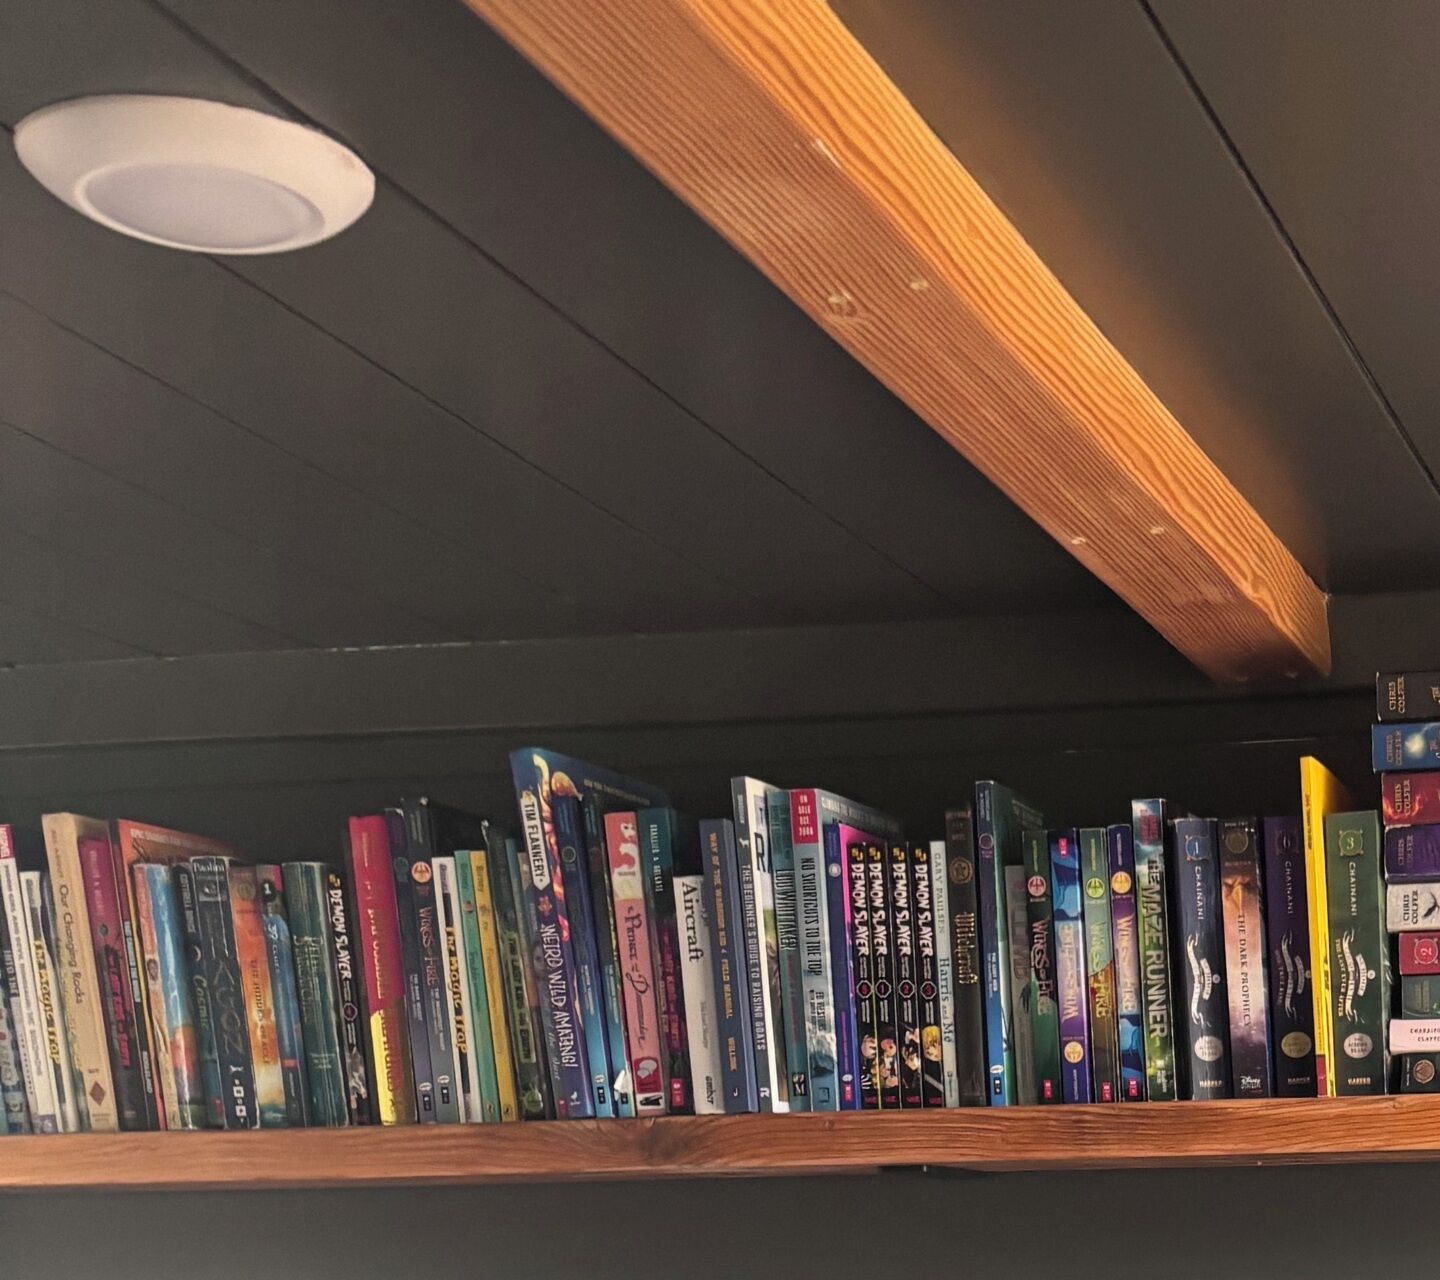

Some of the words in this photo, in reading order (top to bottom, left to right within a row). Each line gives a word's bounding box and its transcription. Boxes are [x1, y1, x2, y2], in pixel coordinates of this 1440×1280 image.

[524, 801, 536, 821] TIM
[527, 822, 545, 879] FLANNERY
[709, 832, 718, 854] WAY
[711, 854, 720, 866] OF
[193, 862, 225, 873] Paolini
[713, 868, 722, 886] THE
[741, 864, 752, 882] THE
[800, 858, 815, 871] NO
[868, 862, 884, 908] DEMON
[892, 862, 909, 908] DEMON
[933, 853, 943, 885] GARY
[1147, 859, 1161, 886] THE
[59, 884, 69, 908] Our
[263, 883, 271, 894] 1
[801, 872, 820, 925] SHORTCUTS
[851, 863, 866, 908] DEMON
[914, 863, 930, 909] DEMON
[1195, 866, 1204, 920] CHAINANI
[1284, 860, 1294, 914] CHAINANI
[1349, 862, 1358, 916] CHAINANI
[329, 889, 347, 932] DEMON
[419, 906, 434, 948] WINGS
[682, 881, 705, 963] Aircraft
[714, 888, 725, 929] WARRIOR
[742, 883, 757, 937] BEGINNER'S
[776, 890, 799, 951] WHITTAKER
[935, 887, 945, 934] PAULSEN
[1141, 887, 1164, 946] MAZE
[1237, 914, 1245, 934] THE
[33, 939, 46, 964] The
[63, 911, 78, 968] Changing
[267, 923, 279, 941] 39
[445, 927, 458, 951] The
[624, 912, 643, 961] PRINCE
[748, 938, 760, 965] GUIDE
[804, 927, 820, 938] TO
[806, 940, 822, 959] THE
[853, 909, 869, 957] SLAYER
[871, 909, 888, 957] SLAYER
[895, 909, 912, 957] SLAYER
[917, 911, 934, 958] SLAYER
[954, 911, 979, 985] Witchcraft
[1031, 915, 1050, 969] WINGS
[1090, 921, 1106, 972] WINGS
[1117, 915, 1134, 966] WINGS
[335, 934, 352, 984] SLAYER
[721, 958, 730, 981] FIELD
[751, 967, 760, 979] TO
[807, 960, 823, 976] TOP
[1239, 939, 1248, 967] DARK
[38, 968, 54, 1021] Magic
[71, 971, 85, 1004] Rocks
[448, 955, 463, 1009] Magic
[722, 983, 734, 1019] MANUAL
[752, 981, 764, 1018] RAISING
[939, 958, 950, 1003] Harris
[1037, 980, 1053, 1016] FIRE
[1095, 981, 1112, 1018] FIRE
[1121, 977, 1138, 1013] FIRE
[1146, 951, 1168, 1039] RUNNER
[1241, 971, 1252, 1027] PROPHECY
[192, 974, 209, 1030] Cosmic
[47, 1026, 61, 1065] Trap
[454, 1015, 467, 1054] Trap
[552, 1010, 579, 1068] AMAZING!
[755, 1021, 767, 1050] GOATS
[944, 1023, 955, 1043] Me
[705, 1075, 717, 1105] amber
